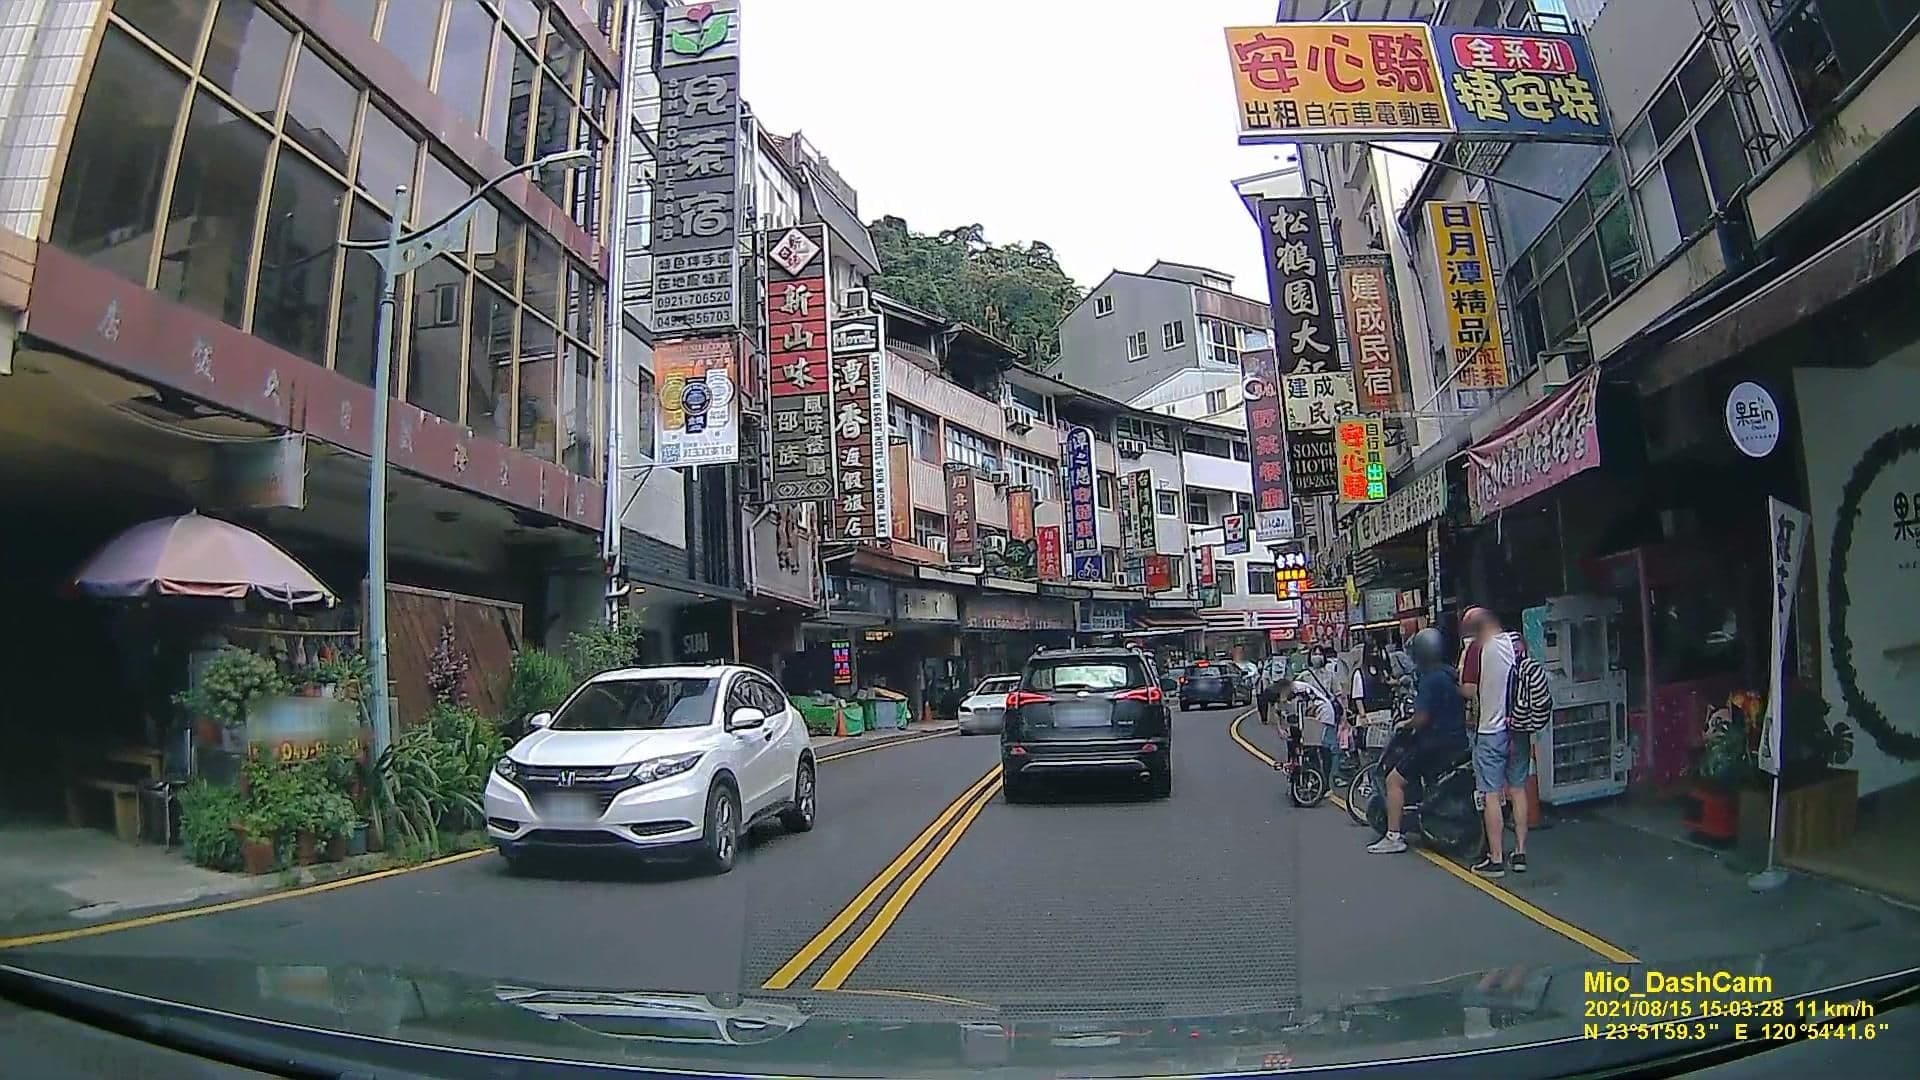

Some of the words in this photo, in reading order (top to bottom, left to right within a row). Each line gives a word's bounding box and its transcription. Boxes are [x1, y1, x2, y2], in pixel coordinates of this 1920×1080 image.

[1234, 33, 1435, 94] 安心騎
[1466, 38, 1563, 69] 全系列
[1245, 103, 1300, 127] 出租
[1305, 102, 1441, 127] 自行車電動車
[1453, 70, 1600, 125] 捷安特
[1270, 205, 1330, 373] 松鶴園大
[1442, 205, 1490, 343] 日月潭精品
[780, 284, 816, 388] 新山味
[1351, 272, 1394, 395] 建成民宿
[1288, 376, 1334, 398] 建成
[1478, 347, 1502, 386] 紅茶
[777, 411, 799, 466] 邵族
